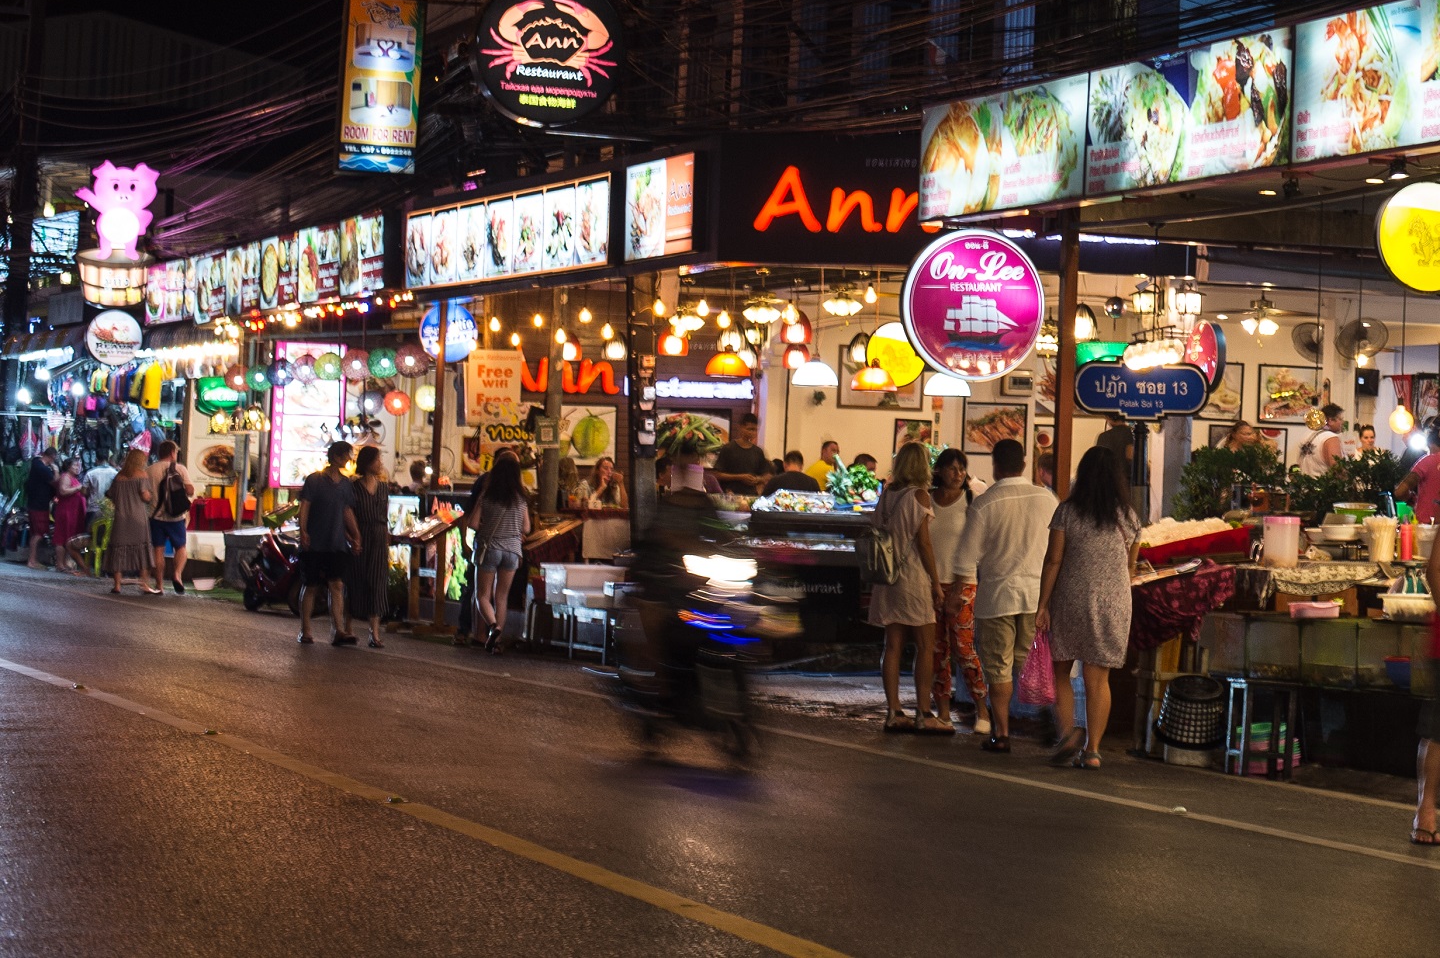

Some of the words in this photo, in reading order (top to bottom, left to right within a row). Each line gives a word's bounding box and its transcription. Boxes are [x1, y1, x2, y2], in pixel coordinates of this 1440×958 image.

[525, 32, 579, 49] Ann
[516, 64, 584, 81] Restaurant
[344, 125, 369, 141] ROOM
[372, 128, 389, 142] FOR
[392, 129, 415, 144] RENT
[667, 179, 692, 201] Ann
[930, 250, 1025, 281] On-Lee
[950, 282, 1003, 292] RESTAURANT
[477, 364, 513, 379] Free
[482, 379, 508, 389] Wifi
[1095, 374, 1127, 399] ปฏัก
[1135, 381, 1166, 395] ซอย
[1172, 381, 1188, 395] 13
[1119, 398, 1139, 408] Patak
[1140, 399, 1153, 408] Soi
[1155, 400, 1164, 409] 13
